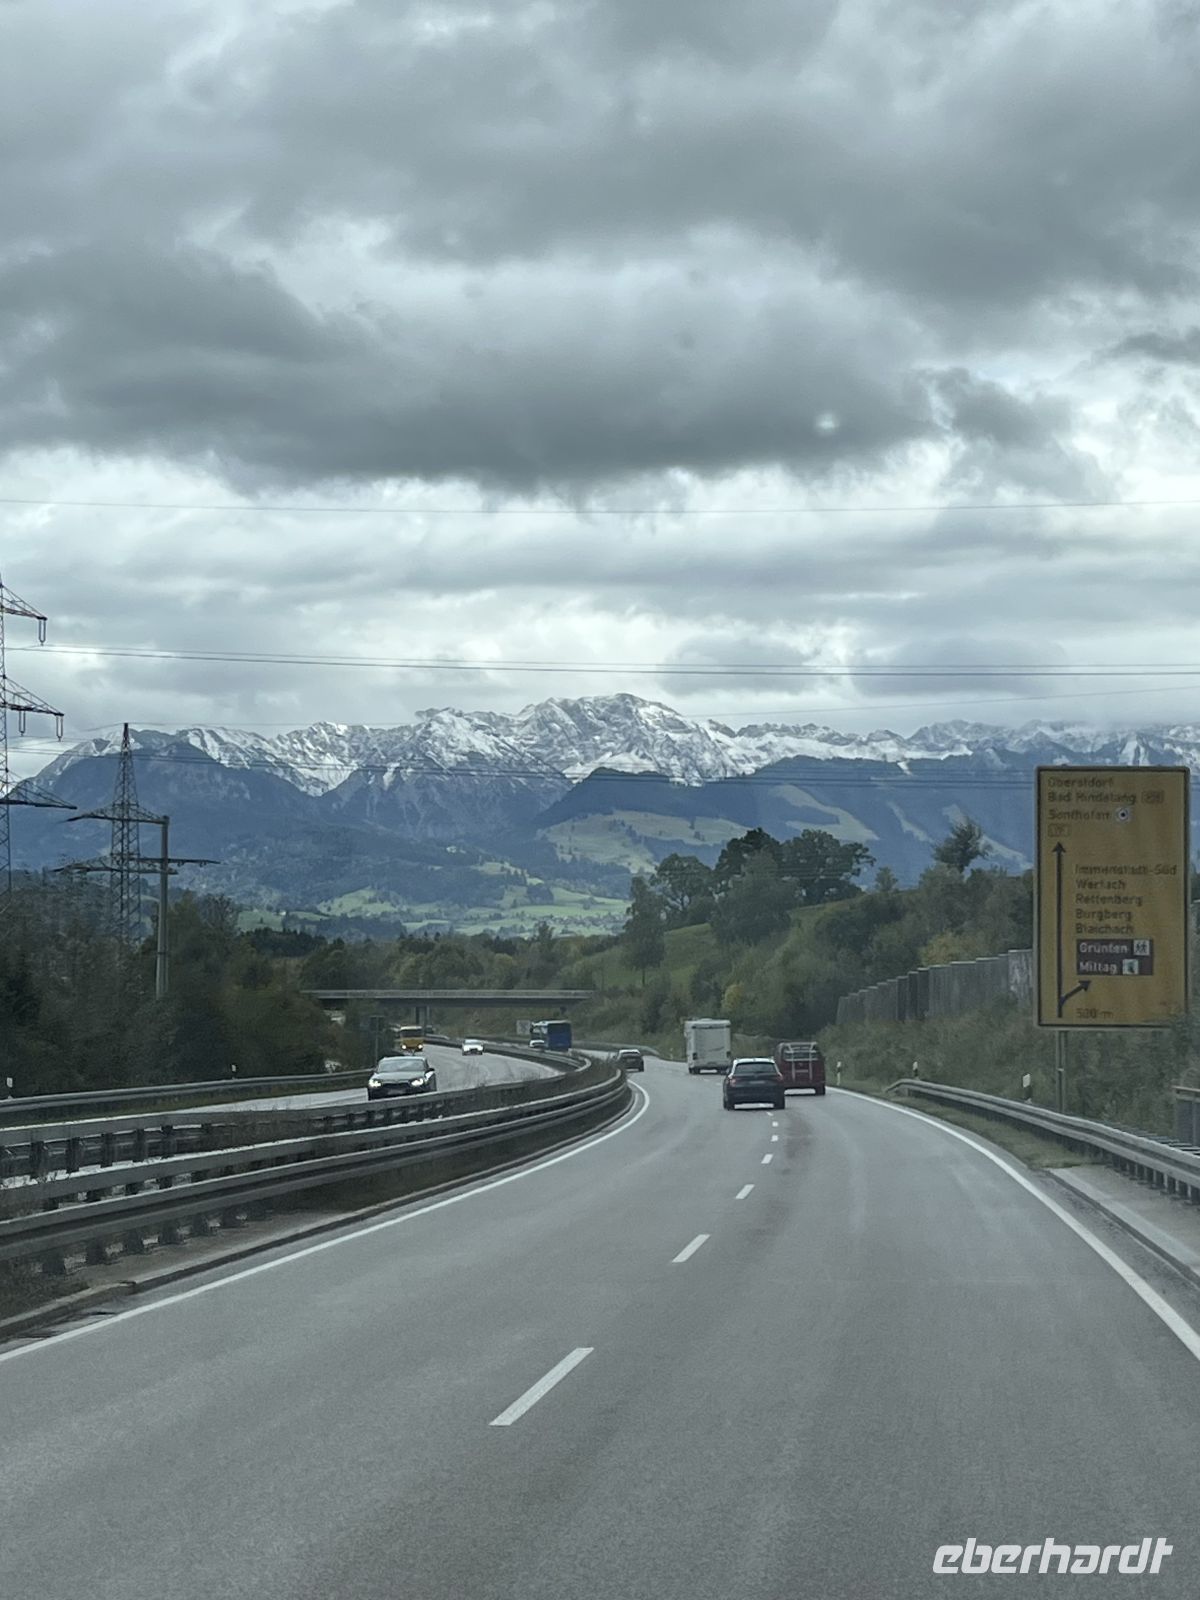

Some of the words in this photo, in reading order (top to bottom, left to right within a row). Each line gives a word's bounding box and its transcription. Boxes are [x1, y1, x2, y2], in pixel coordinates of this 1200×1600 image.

[1076, 893, 1143, 907] Rettenberg
[1076, 908, 1132, 921] Burgberg
[1079, 942, 1128, 953] Grünten
[1079, 961, 1117, 974] Mittag
